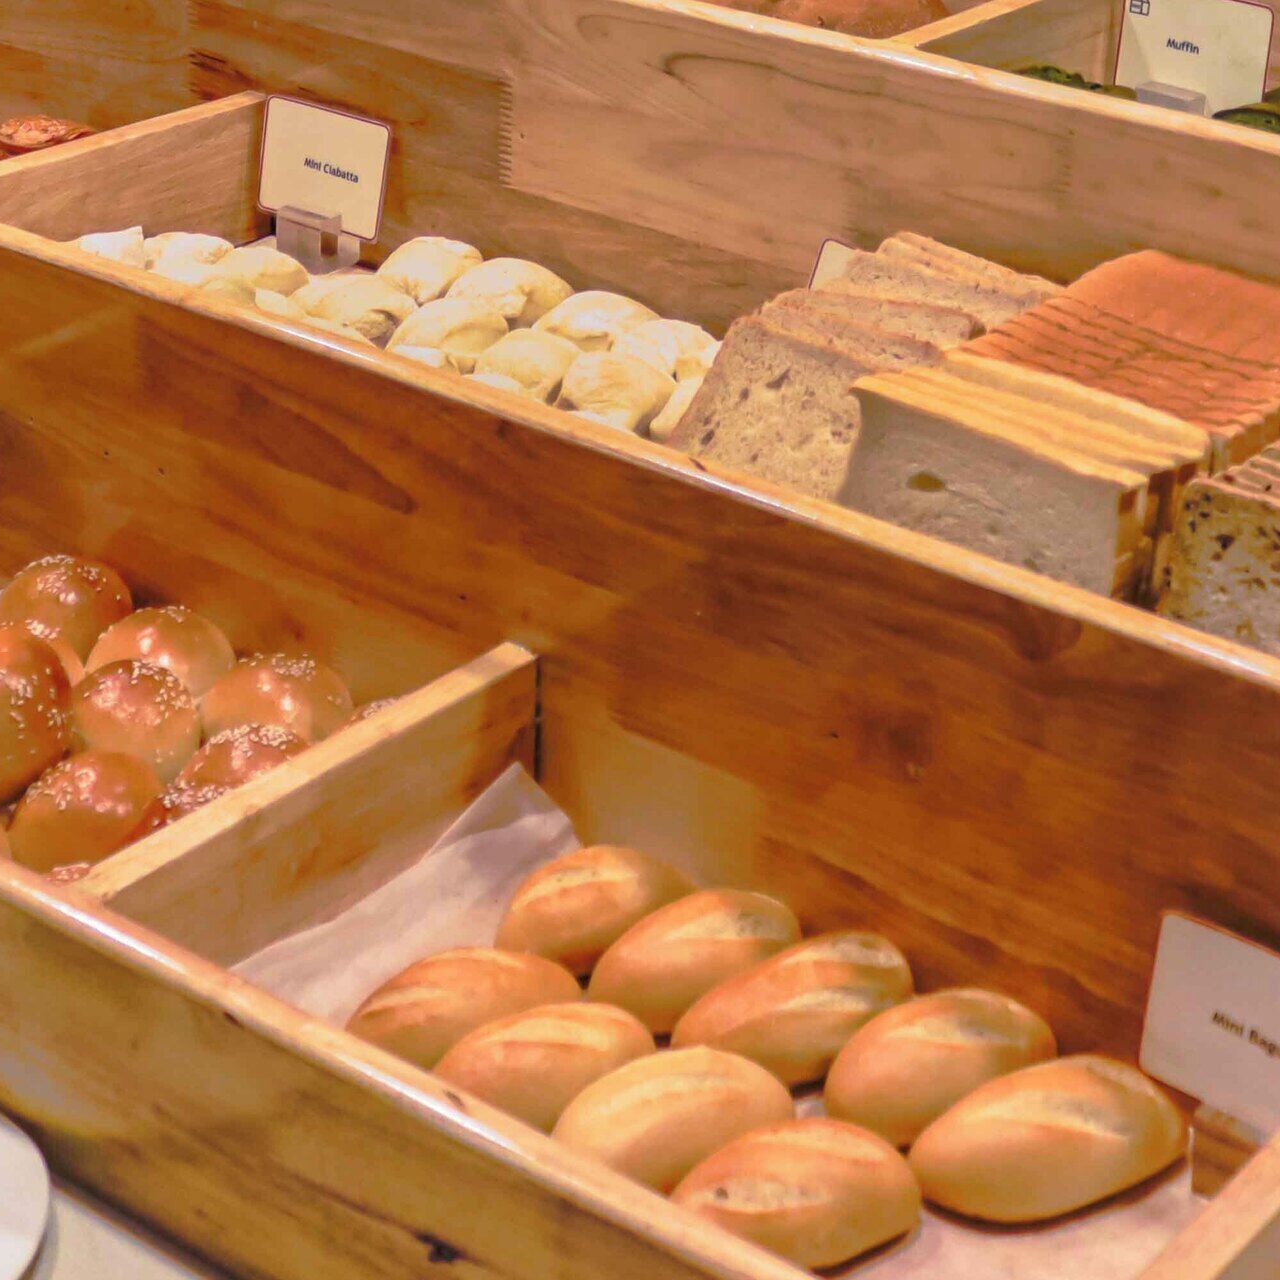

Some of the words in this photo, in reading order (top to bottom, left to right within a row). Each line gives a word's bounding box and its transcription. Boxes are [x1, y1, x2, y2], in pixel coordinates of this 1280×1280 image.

[1166, 38, 1200, 55] Muffin
[304, 157, 321, 172] Mini
[323, 163, 359, 184] Ciabatta
[1212, 1011, 1244, 1037] Mini
